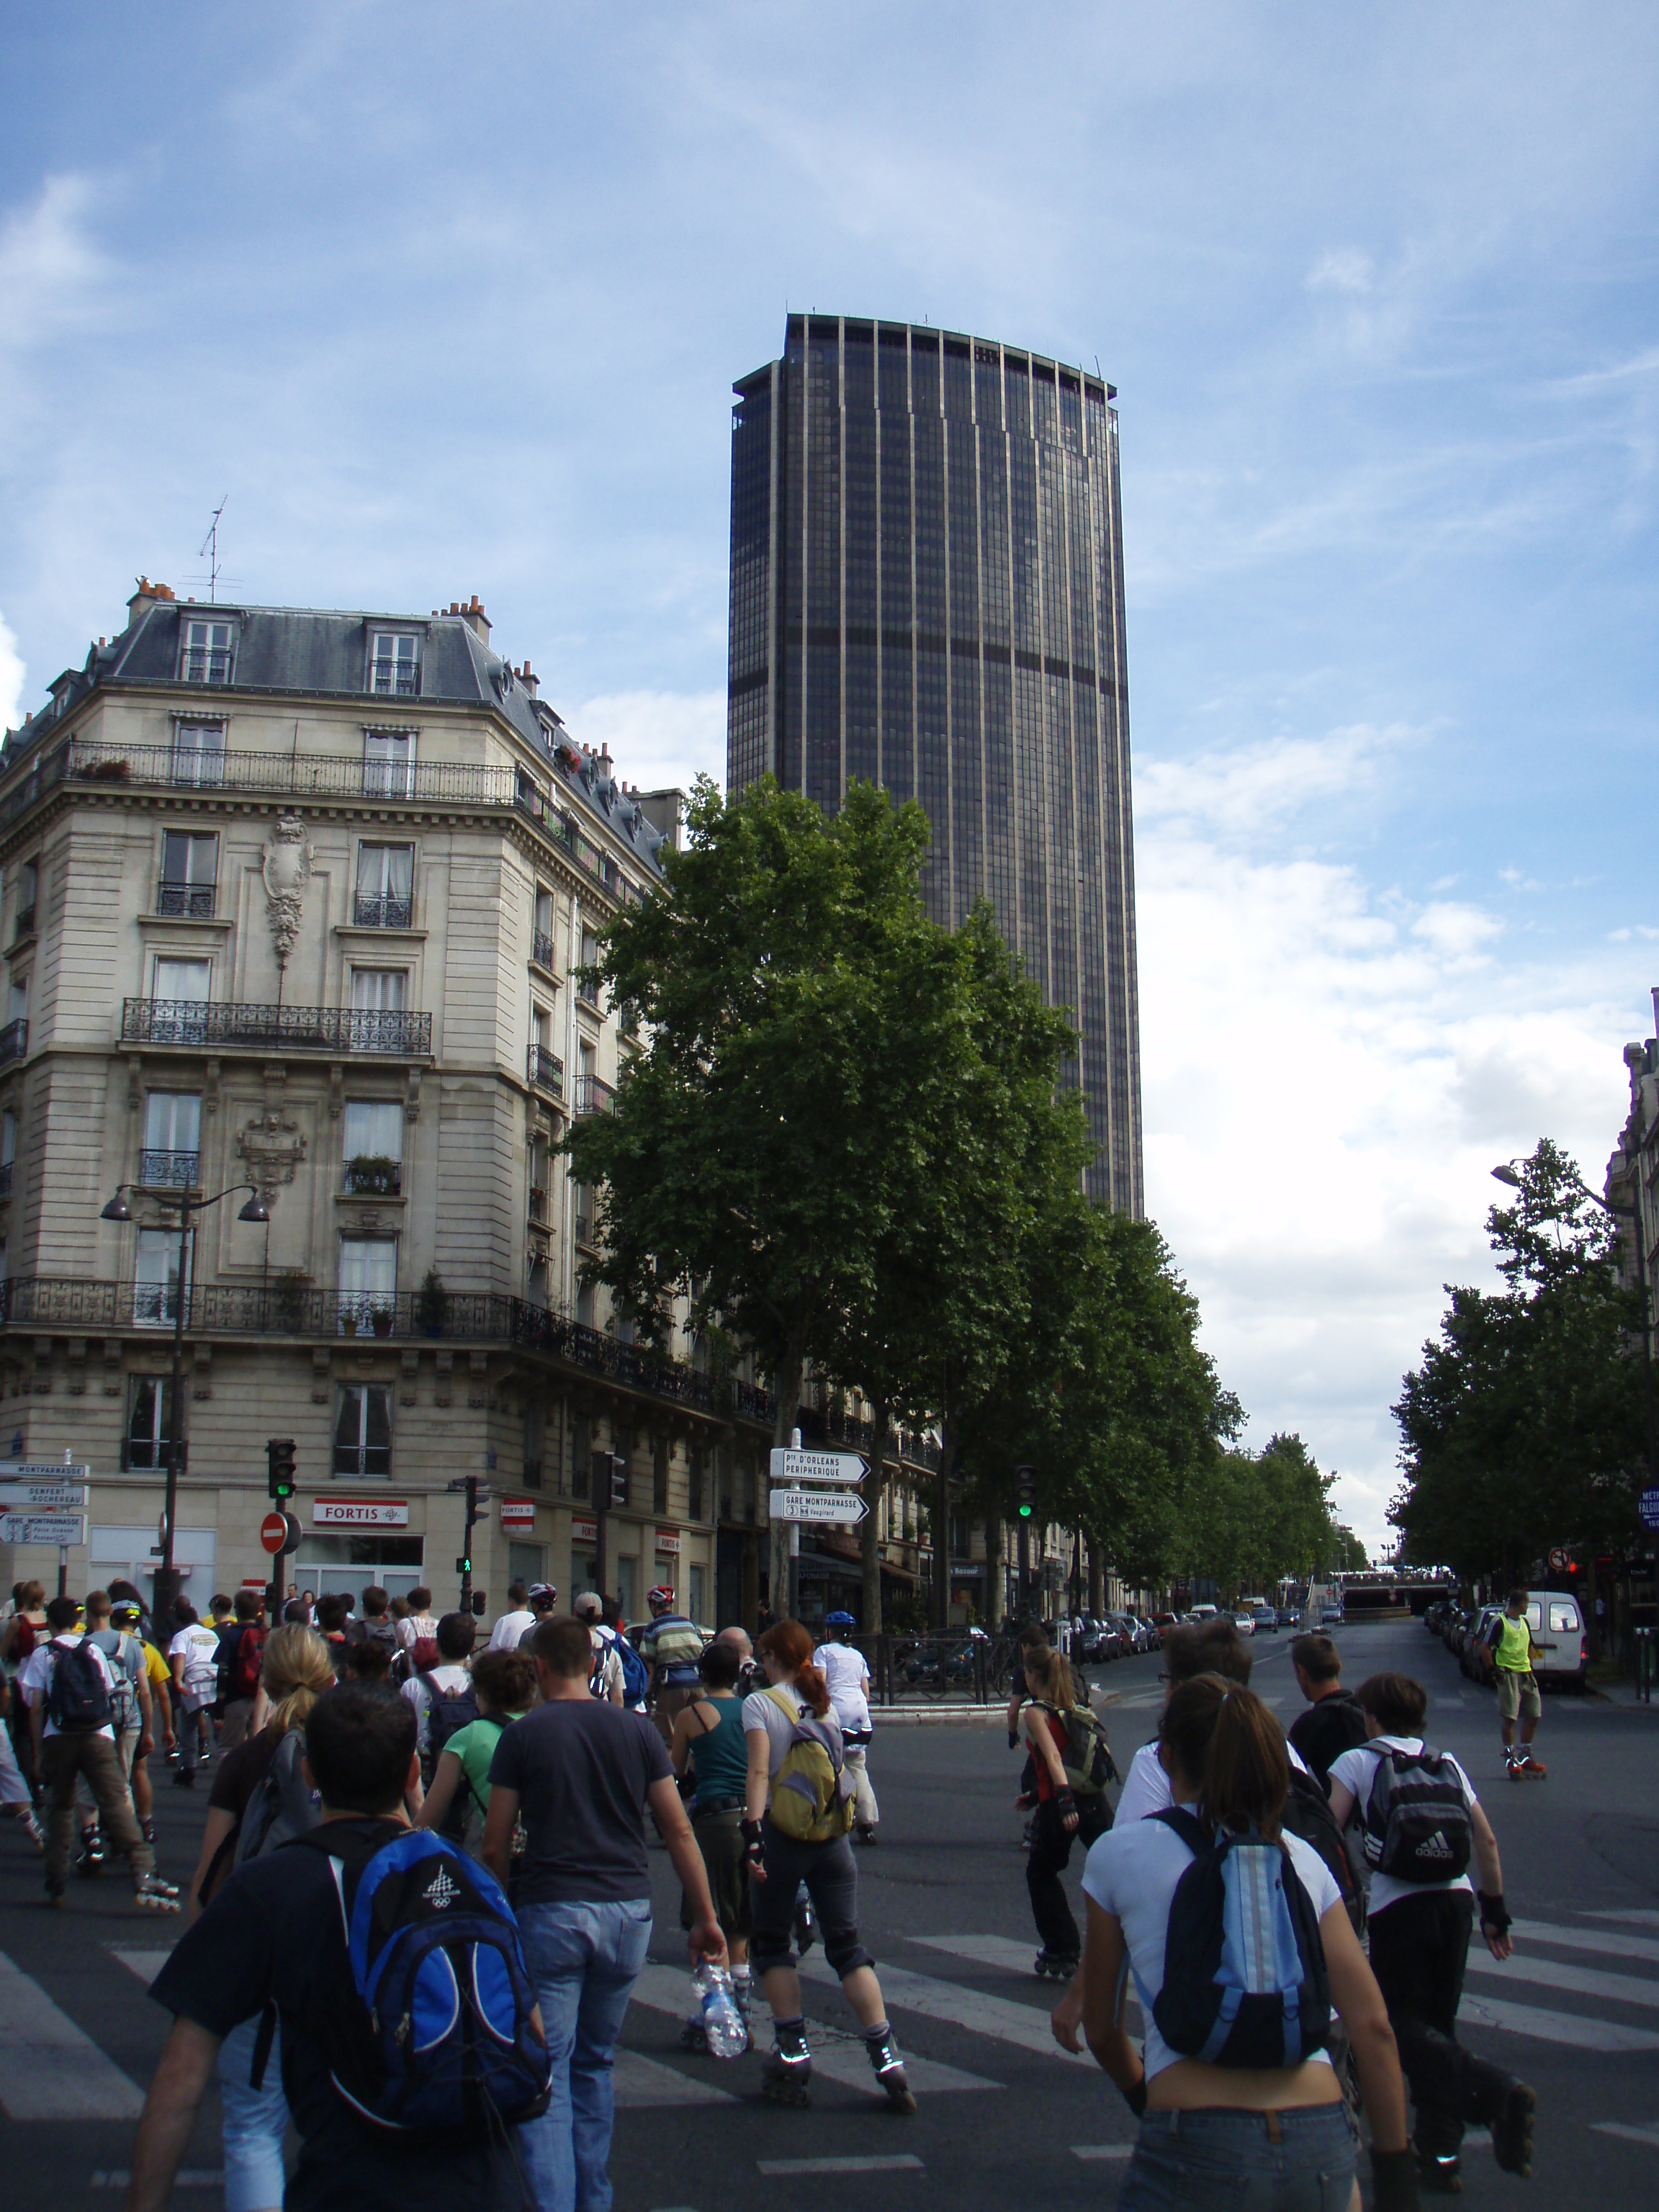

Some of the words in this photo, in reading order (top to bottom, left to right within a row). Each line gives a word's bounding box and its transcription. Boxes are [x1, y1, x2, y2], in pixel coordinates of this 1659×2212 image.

[800, 1455, 840, 1466] D'ORLEANS
[786, 1465, 840, 1476] PERIPHERIQUE
[806, 1498, 857, 1508] MONTPARNASSE
[325, 1508, 377, 1519] FORTIS
[662, 1538, 675, 1548] FORTIS
[1416, 1848, 1453, 1858] adidas
